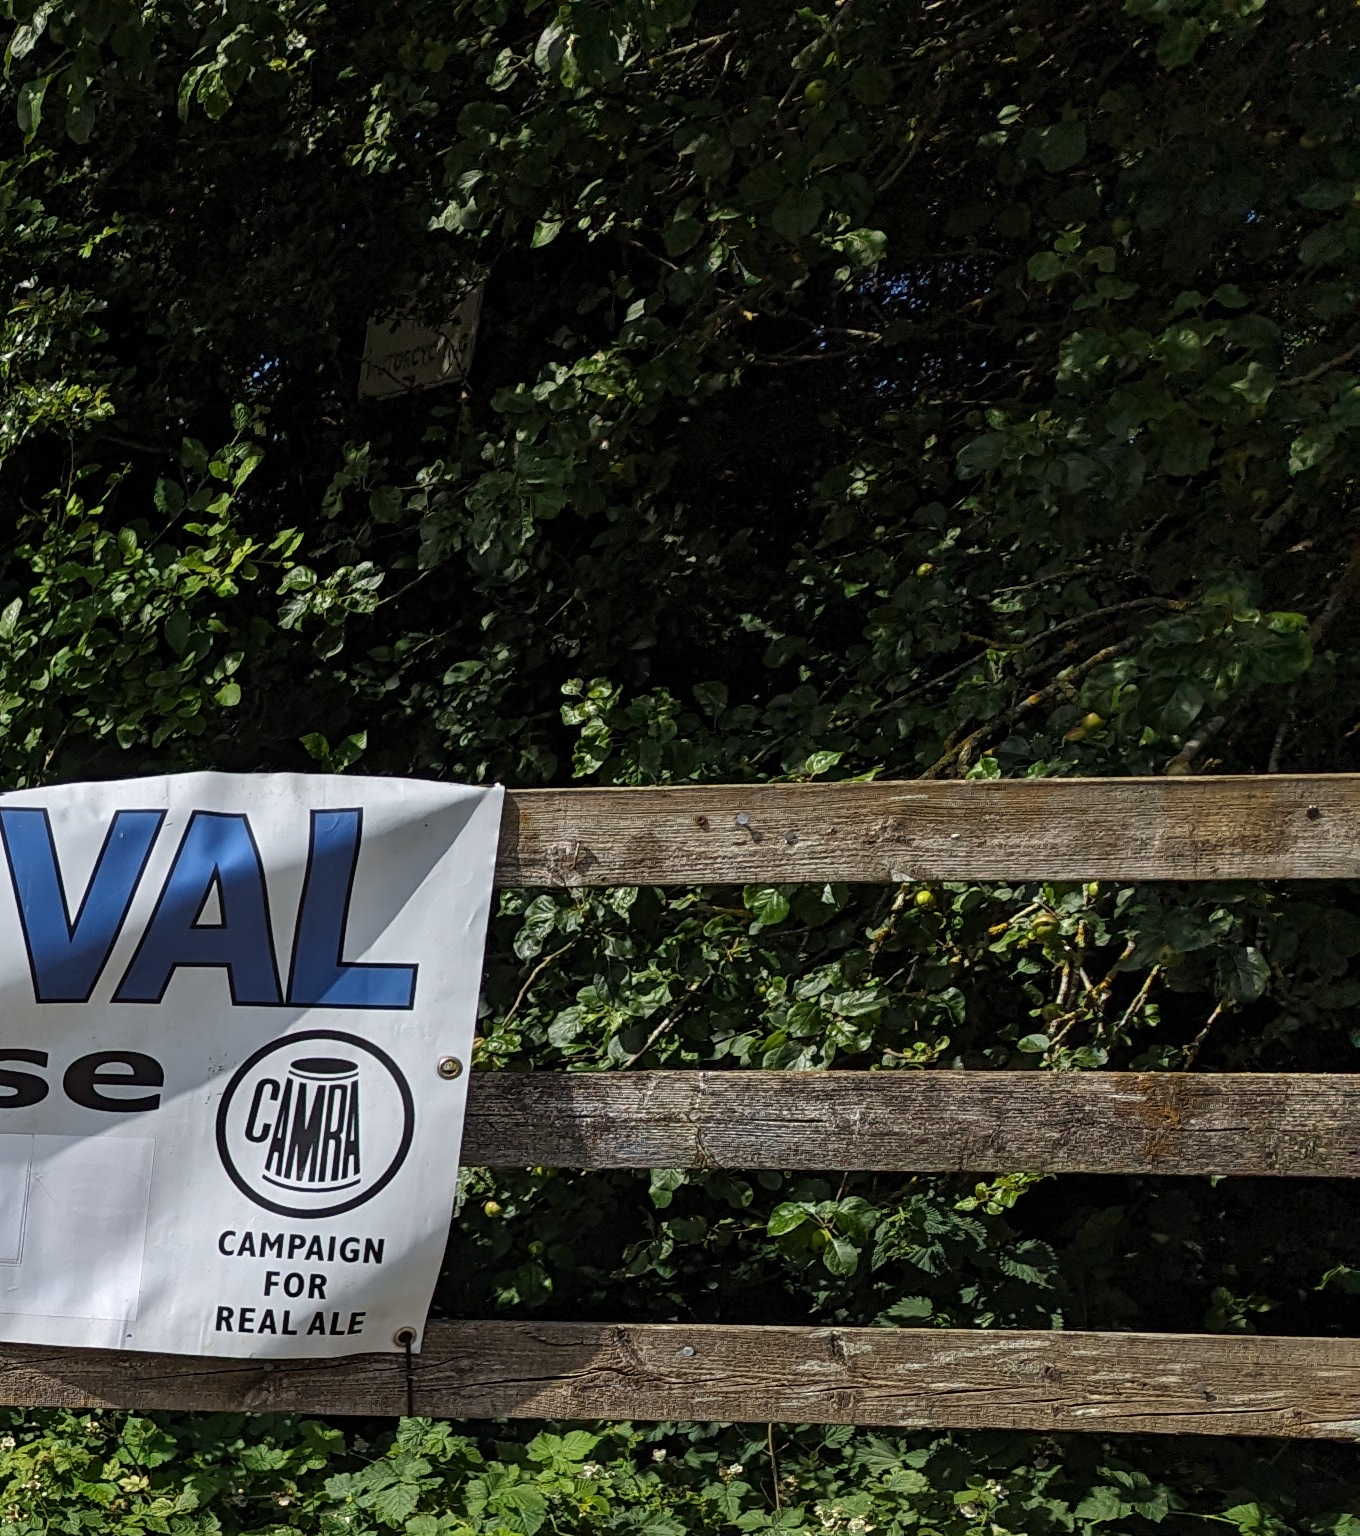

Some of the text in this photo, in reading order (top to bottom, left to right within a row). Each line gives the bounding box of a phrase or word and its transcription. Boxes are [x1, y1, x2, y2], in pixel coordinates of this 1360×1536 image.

[243, 1076, 362, 1184] CAMRA
[218, 1229, 385, 1265] CAMPAIGN
[263, 1270, 328, 1300] FOR
[215, 1306, 367, 1337] REAL ALE
